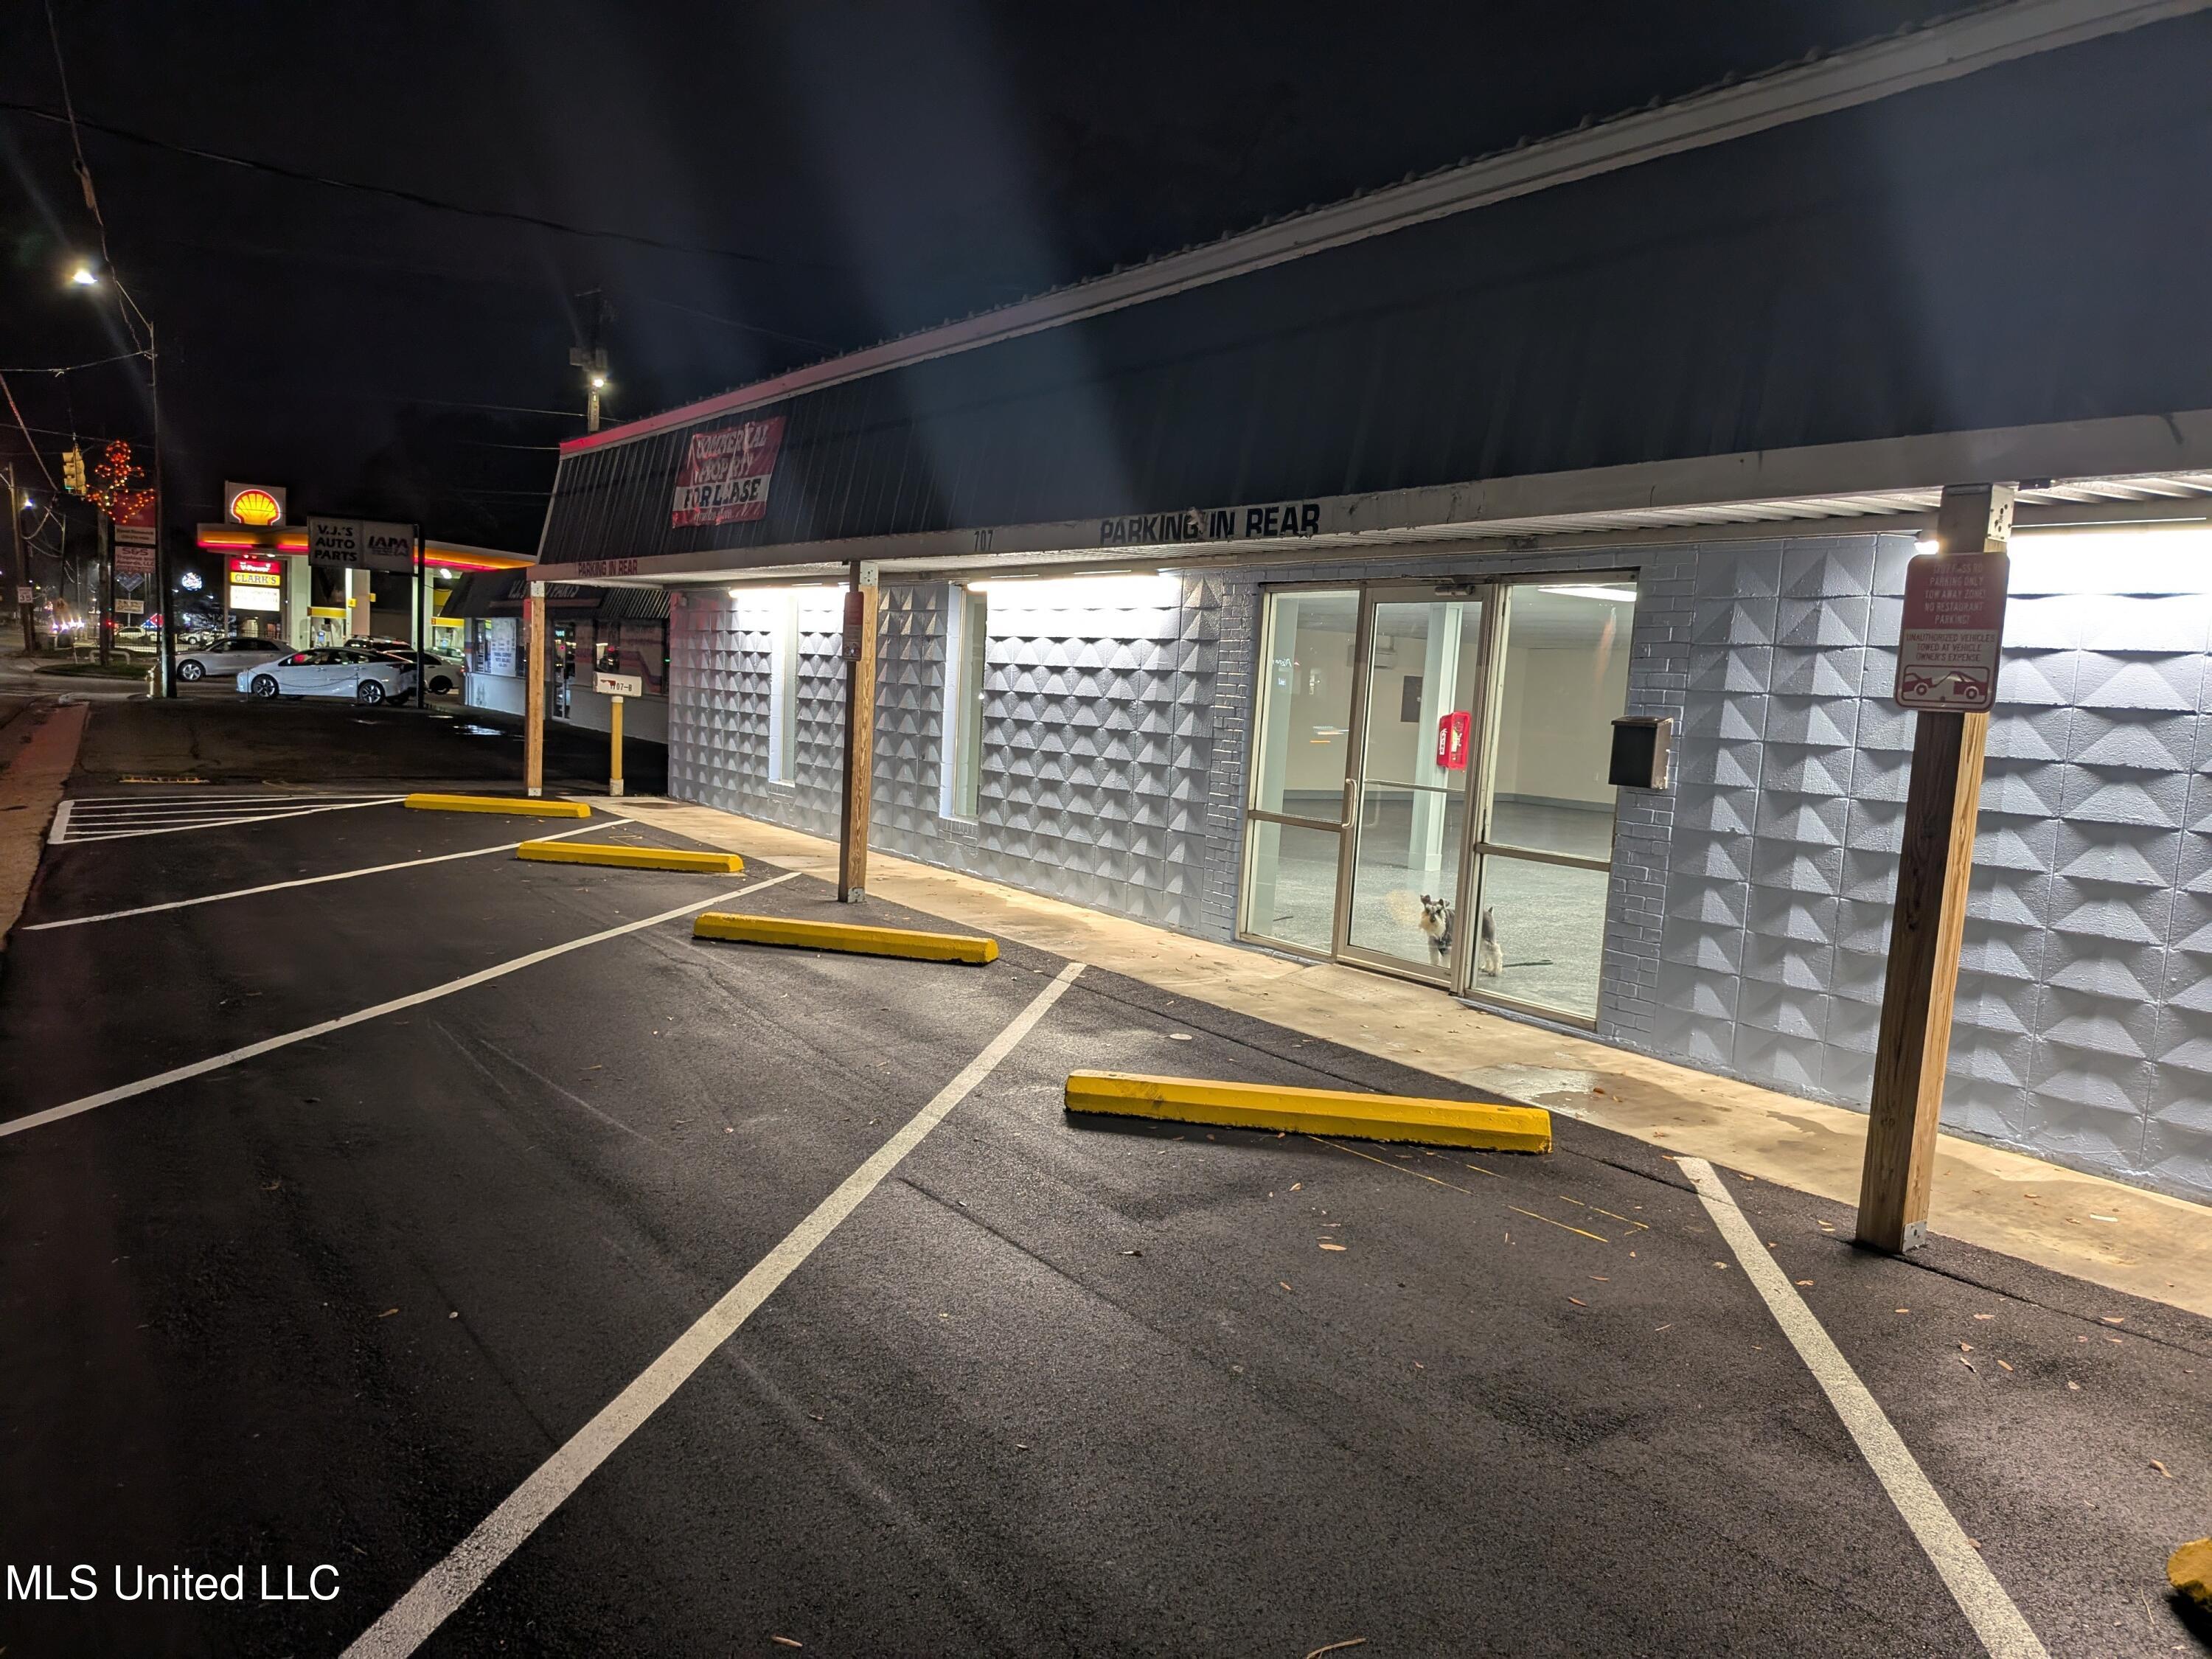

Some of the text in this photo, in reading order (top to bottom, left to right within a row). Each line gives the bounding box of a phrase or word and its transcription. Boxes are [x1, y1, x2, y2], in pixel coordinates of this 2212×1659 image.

[712, 478, 762, 506] LASE
[1100, 504, 1320, 545] PARKING IN REAR
[316, 537, 355, 549] AUTO
[314, 550, 357, 561] PARTS
[579, 560, 638, 577] PARKING IN REAR
[235, 574, 276, 585] CLARK'S
[1930, 576, 1984, 586] PARKING ONLY
[1925, 589, 1941, 599] TOW
[1941, 589, 1962, 599] AWAY
[1924, 602, 1984, 613] NO RESTAURANT
[1907, 633, 1995, 643] UNAUTHORIZED VEHICLES
[1916, 643, 1982, 652] TOWED AT VEHICLE
[1916, 652, 1981, 662] OWNER'S EXPENSE
